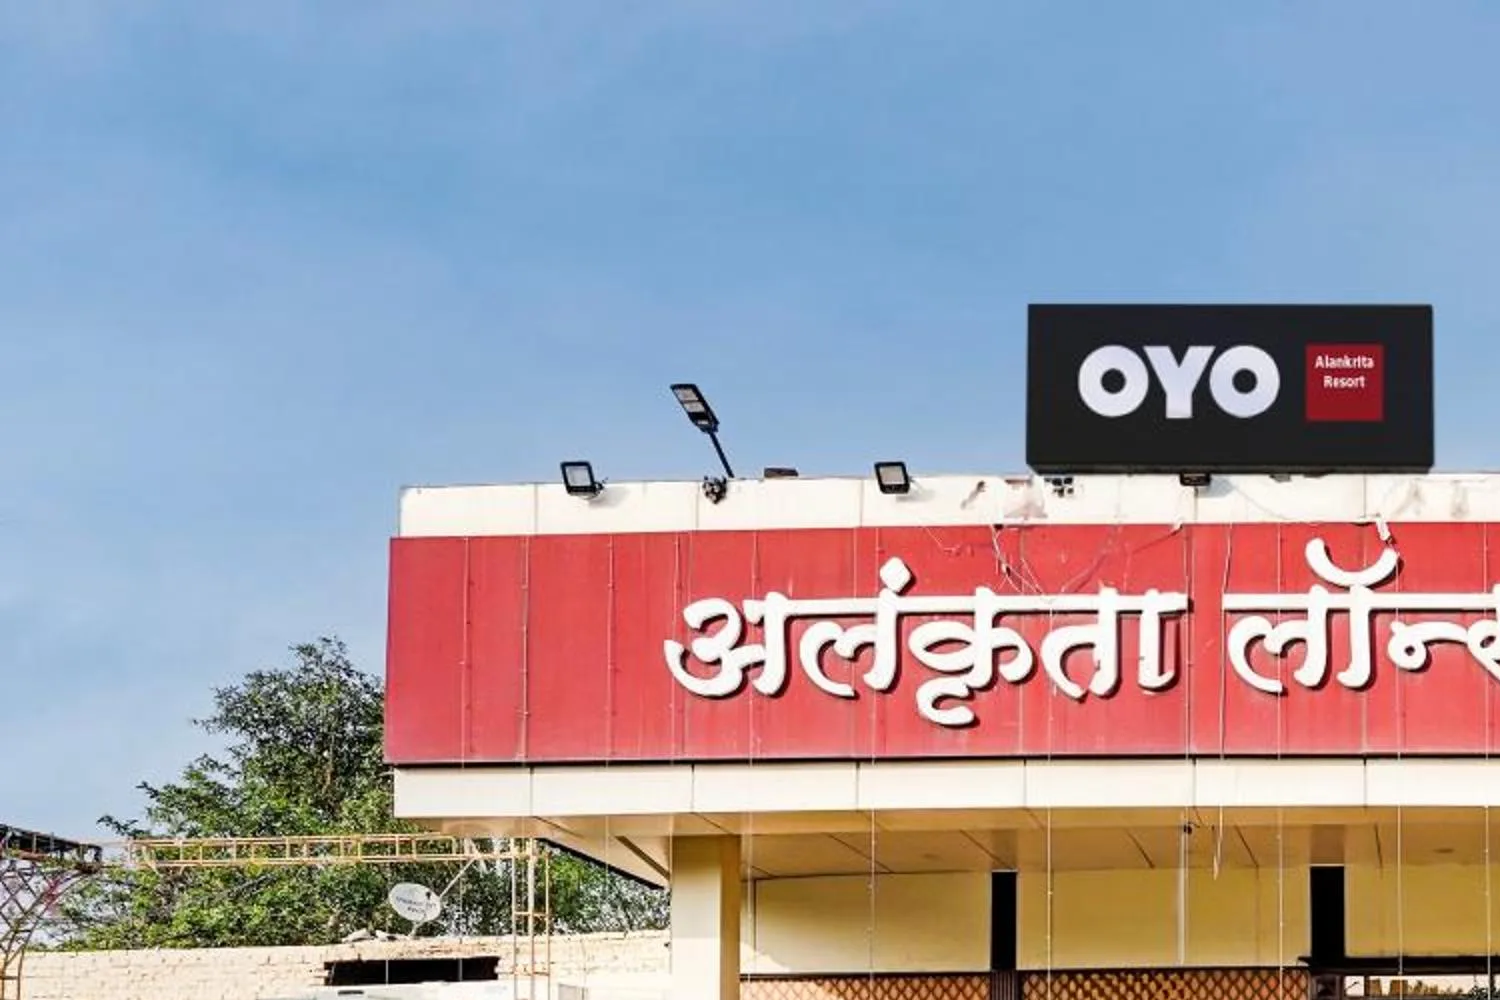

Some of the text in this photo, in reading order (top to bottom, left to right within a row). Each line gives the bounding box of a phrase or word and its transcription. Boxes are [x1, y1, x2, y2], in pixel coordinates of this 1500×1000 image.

[1077, 344, 1281, 418] OYO
[1314, 354, 1375, 369] Alankrita
[1323, 375, 1365, 388] Resort
[663, 556, 1189, 727] अलंकृता
